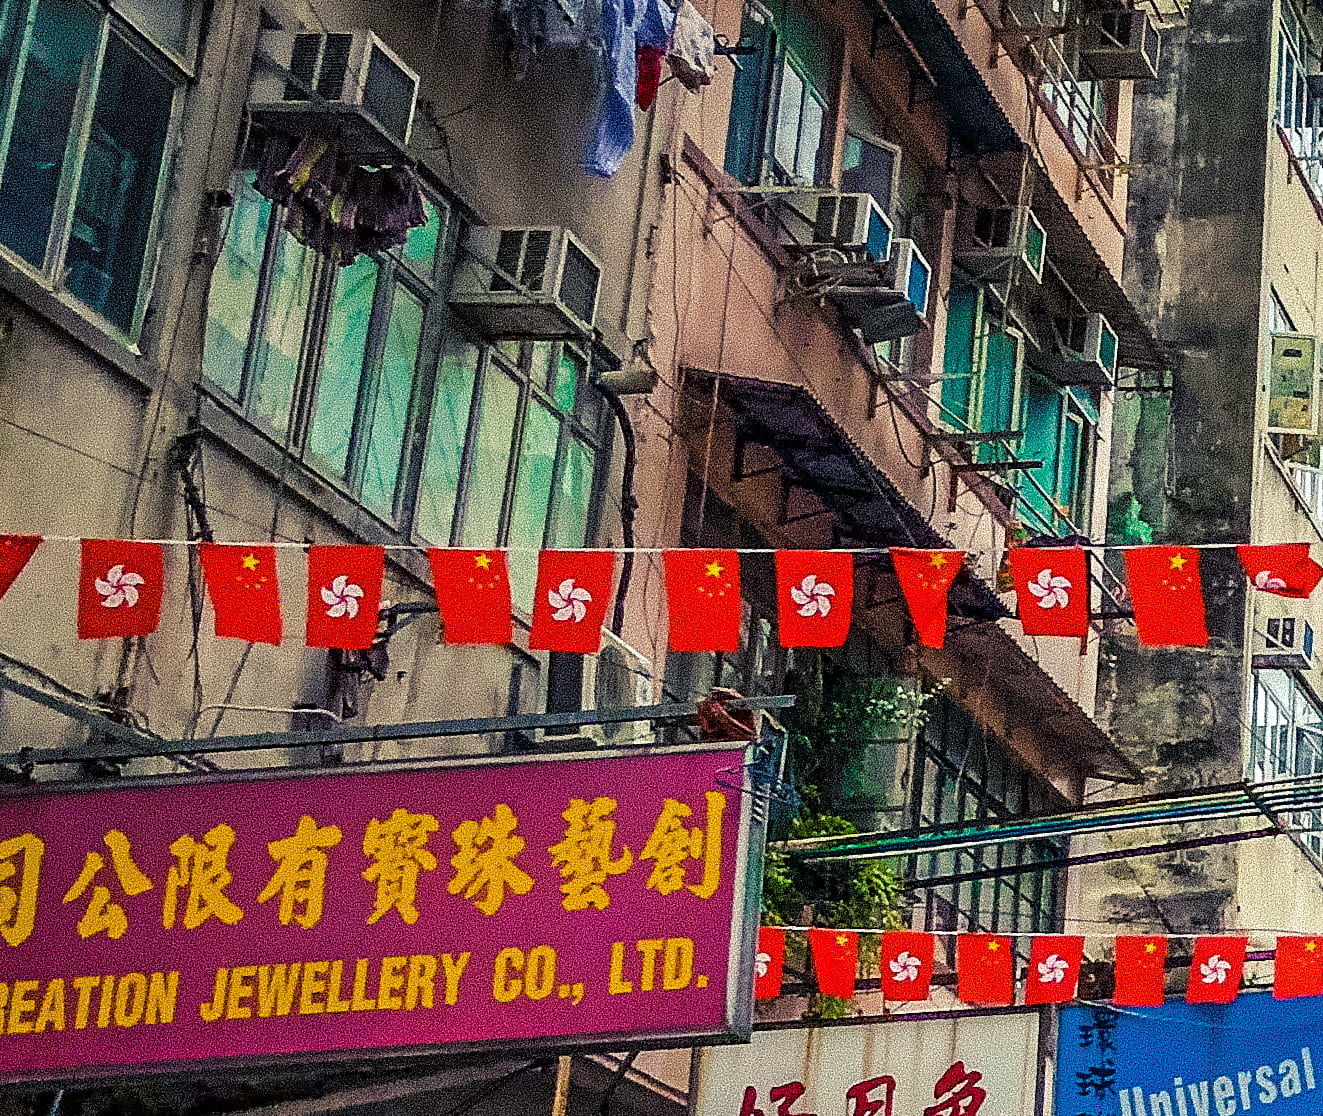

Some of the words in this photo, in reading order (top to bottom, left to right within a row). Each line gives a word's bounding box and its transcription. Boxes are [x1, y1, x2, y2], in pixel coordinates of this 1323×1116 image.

[200, 951, 471, 1023] JEWELLERY
[492, 946, 585, 1007] CO.,
[608, 936, 709, 997] LTD.
